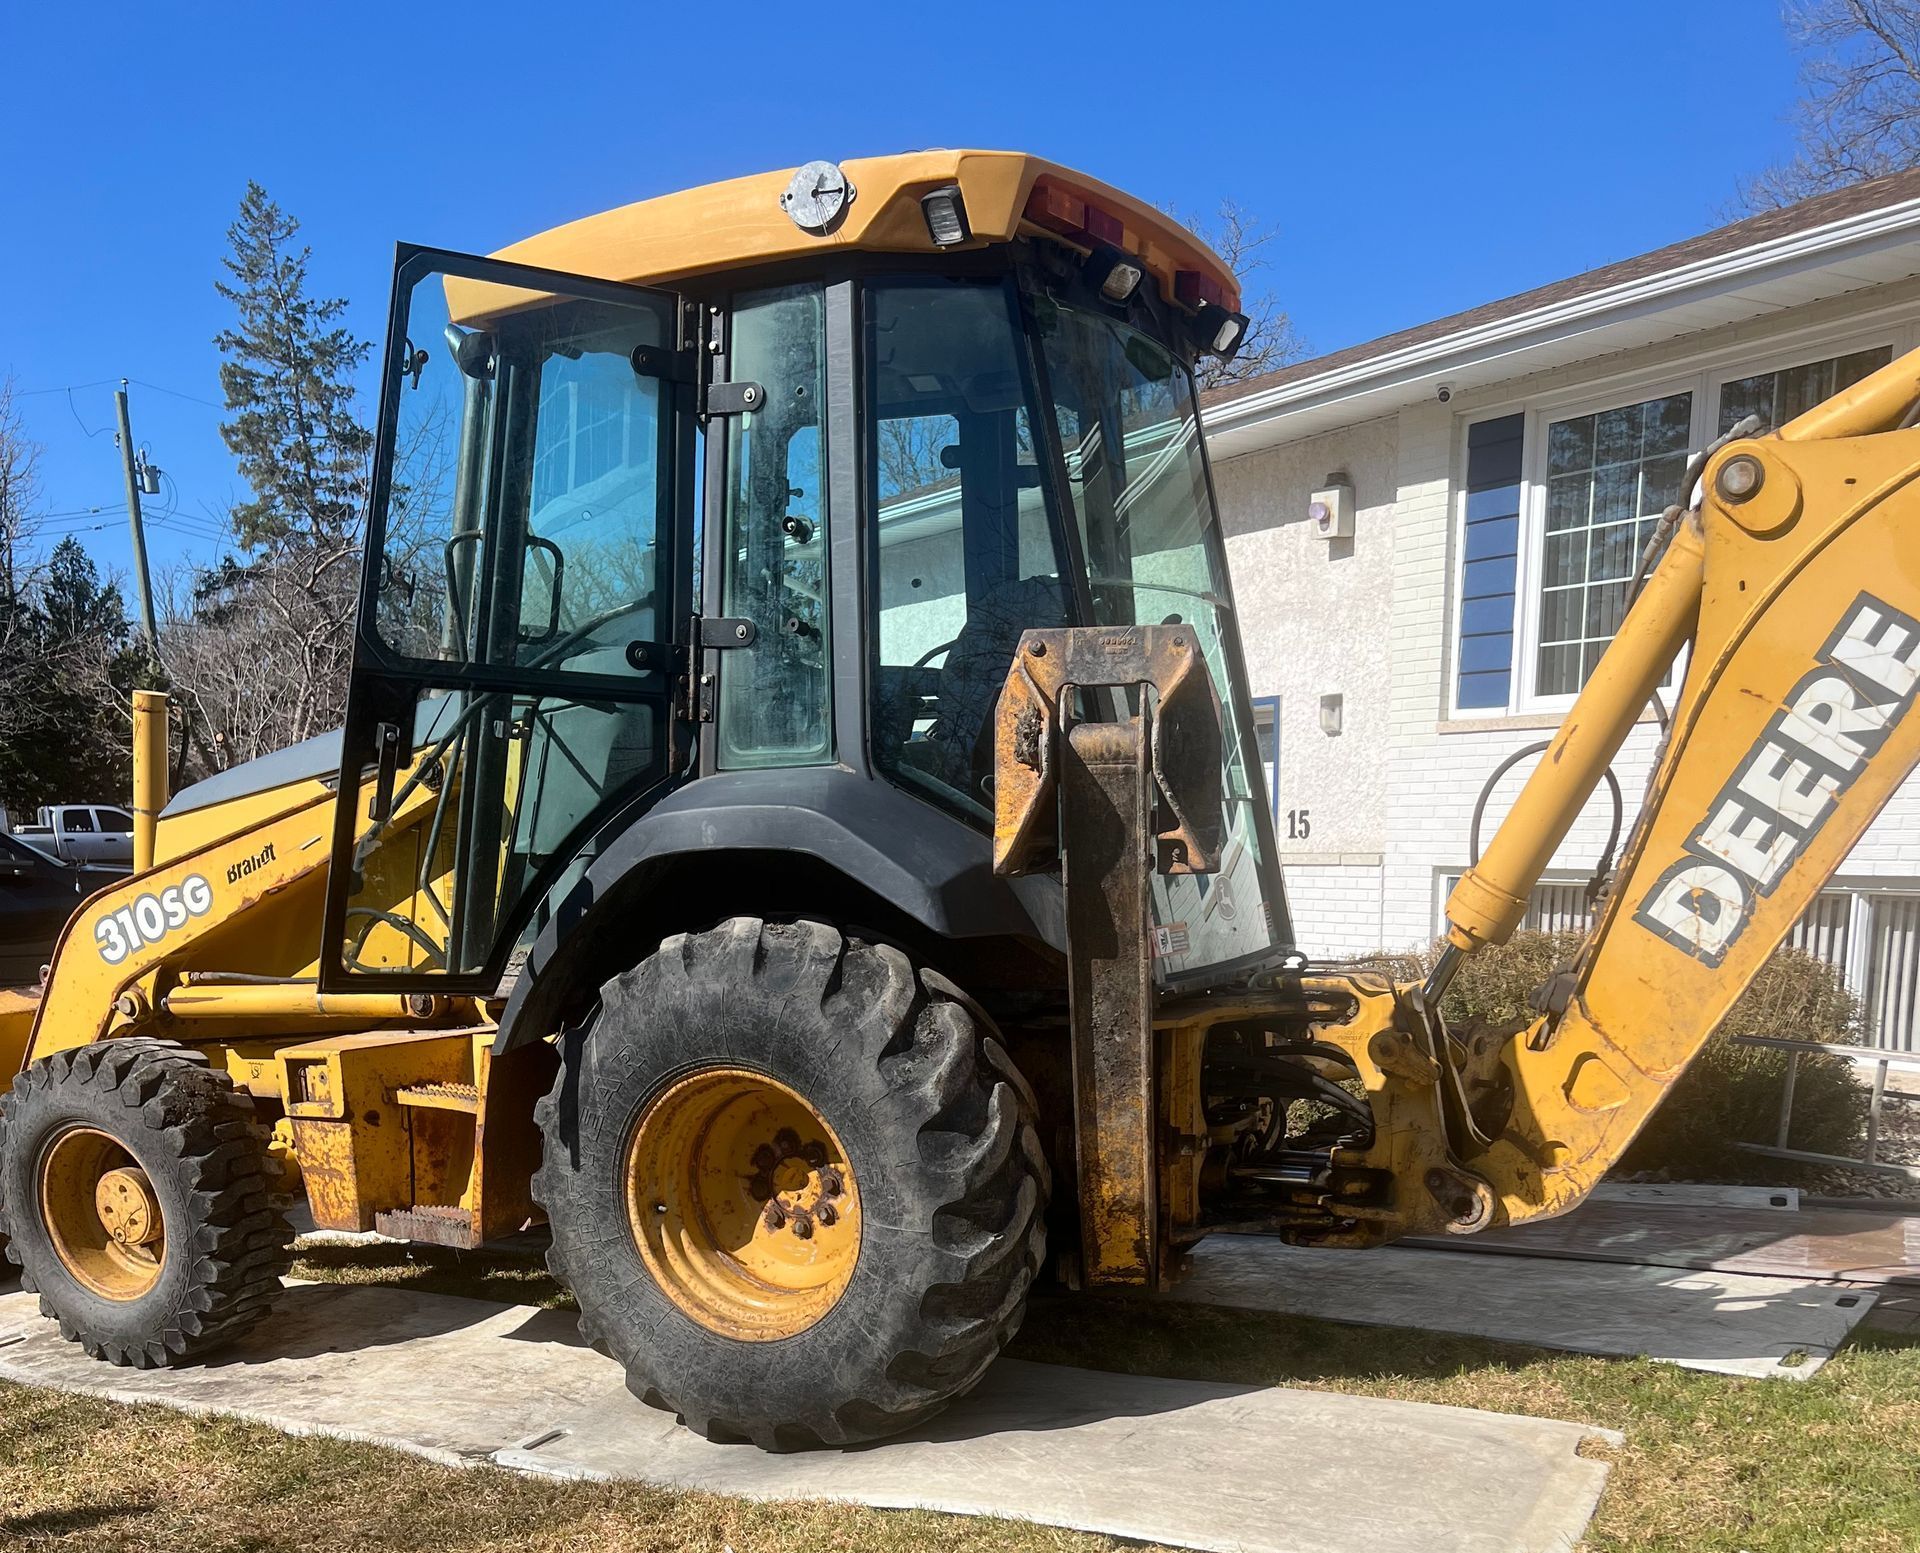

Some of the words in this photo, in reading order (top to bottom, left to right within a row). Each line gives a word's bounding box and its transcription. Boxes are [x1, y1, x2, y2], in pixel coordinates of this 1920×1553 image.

[1287, 809, 1311, 840] 15
[1643, 602, 1920, 958] DEERE
[95, 874, 212, 964] 310SG
